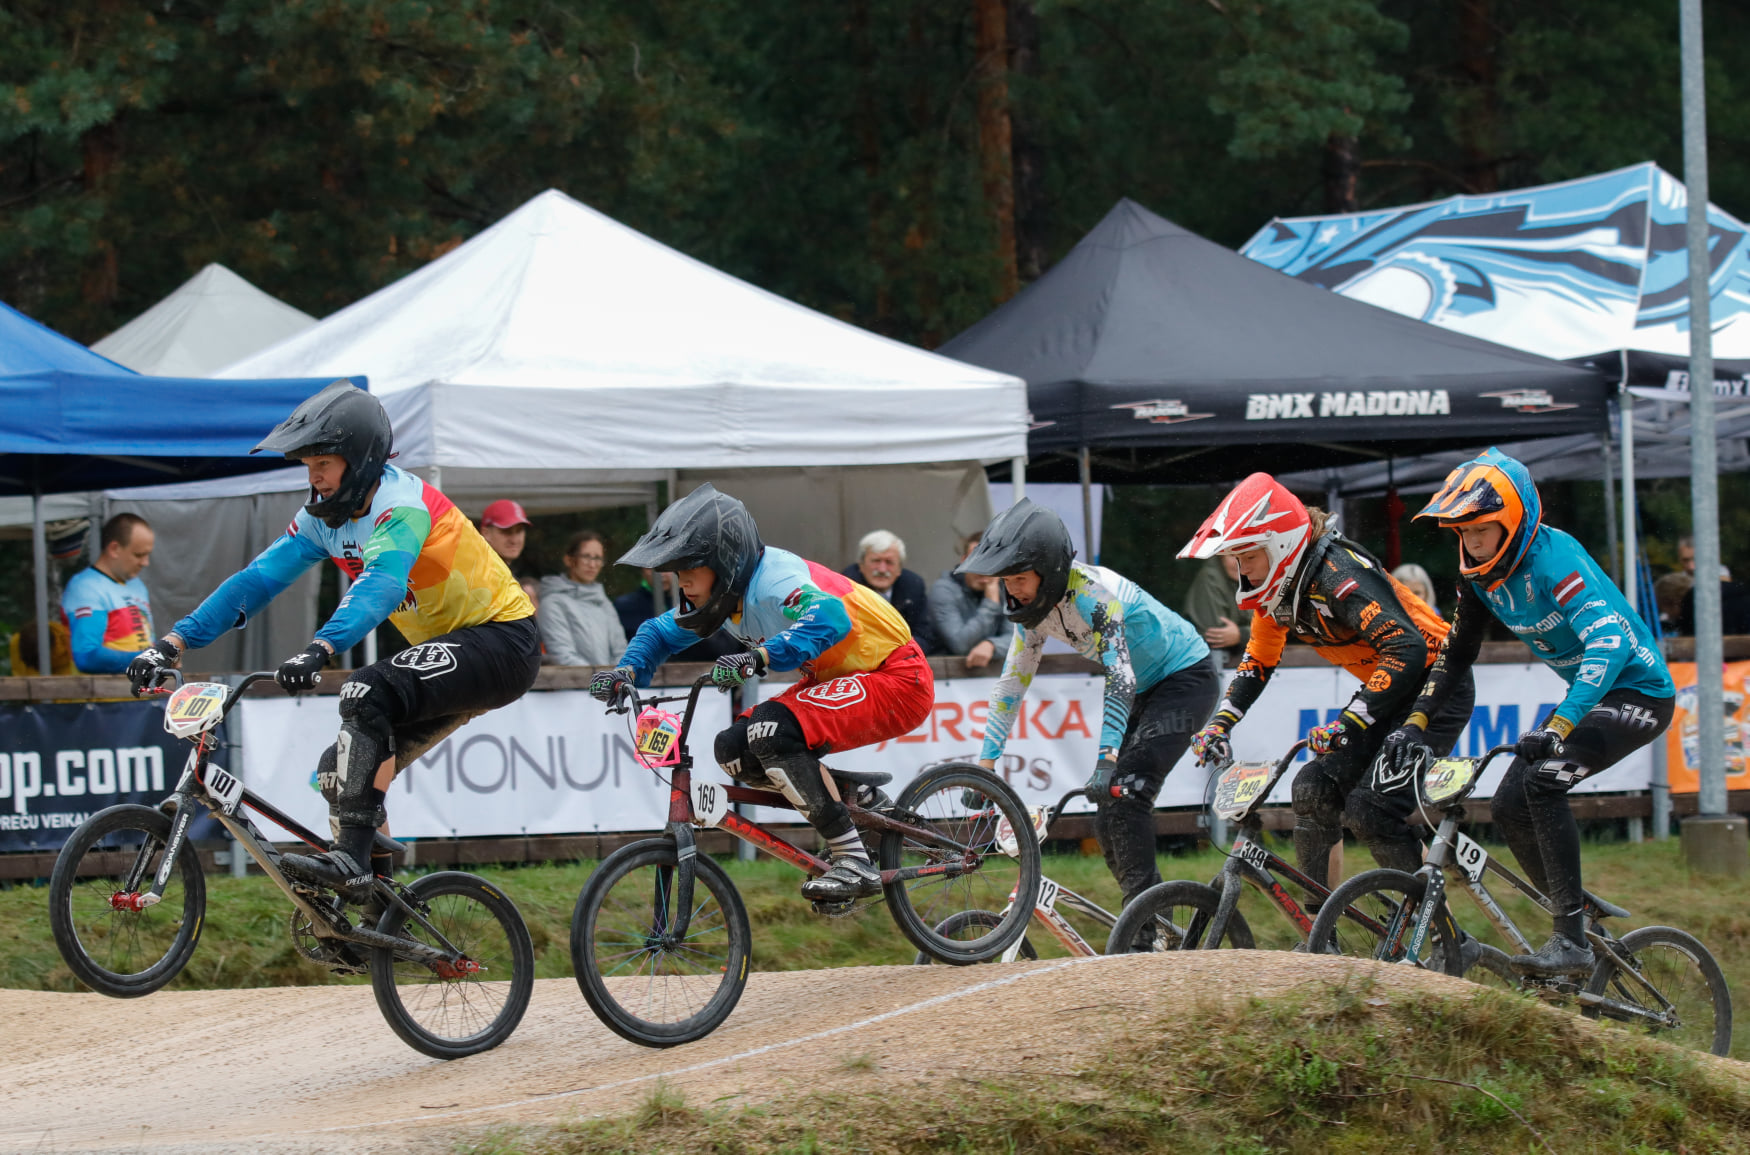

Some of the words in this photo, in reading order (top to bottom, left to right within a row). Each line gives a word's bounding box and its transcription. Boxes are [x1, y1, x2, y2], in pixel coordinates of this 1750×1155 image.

[1245, 395, 1313, 420] BMX
[1320, 392, 1449, 416] MADONA
[1578, 614, 1618, 643] EYBO
[184, 697, 213, 717] 101
[648, 730, 670, 753] 169
[210, 769, 236, 798] 101
[1435, 769, 1456, 788] 19
[698, 783, 716, 814] 169
[0, 811, 41, 831] REČU
[1241, 841, 1266, 867] 349
[1459, 842, 1480, 865] 19
[1038, 880, 1056, 908] 12
[1271, 882, 1313, 933] MEYB
[1412, 900, 1435, 955] ANSWER
